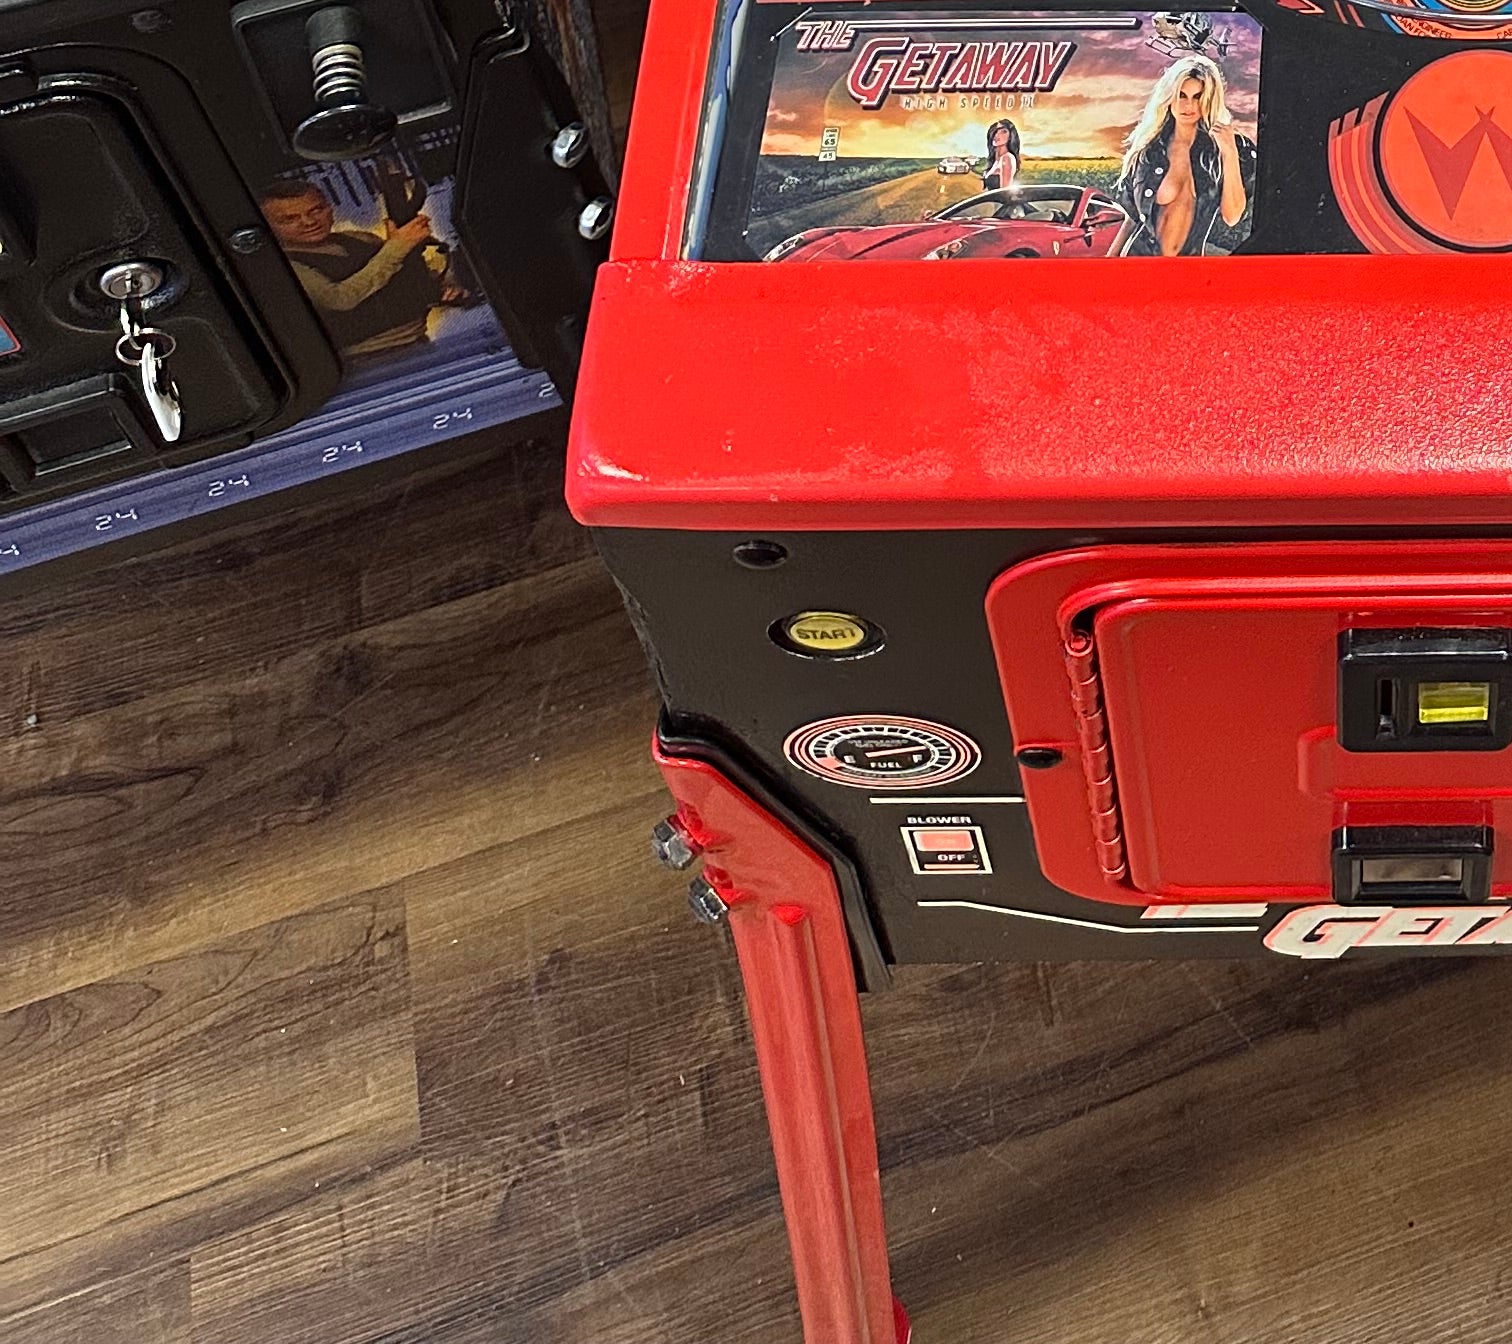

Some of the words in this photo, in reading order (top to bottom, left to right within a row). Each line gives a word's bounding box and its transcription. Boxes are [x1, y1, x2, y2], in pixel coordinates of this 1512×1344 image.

[796, 20, 857, 51] THE
[847, 36, 1077, 110] GETAWAY
[903, 96, 946, 110] HIGH
[960, 96, 1014, 110] SPEED
[433, 406, 475, 431] 24
[321, 440, 364, 465] 24
[208, 473, 250, 498] 24
[796, 625, 858, 642] START
[870, 761, 902, 769] FUEL
[907, 816, 972, 825] BLOWER
[937, 853, 966, 862] OFF
